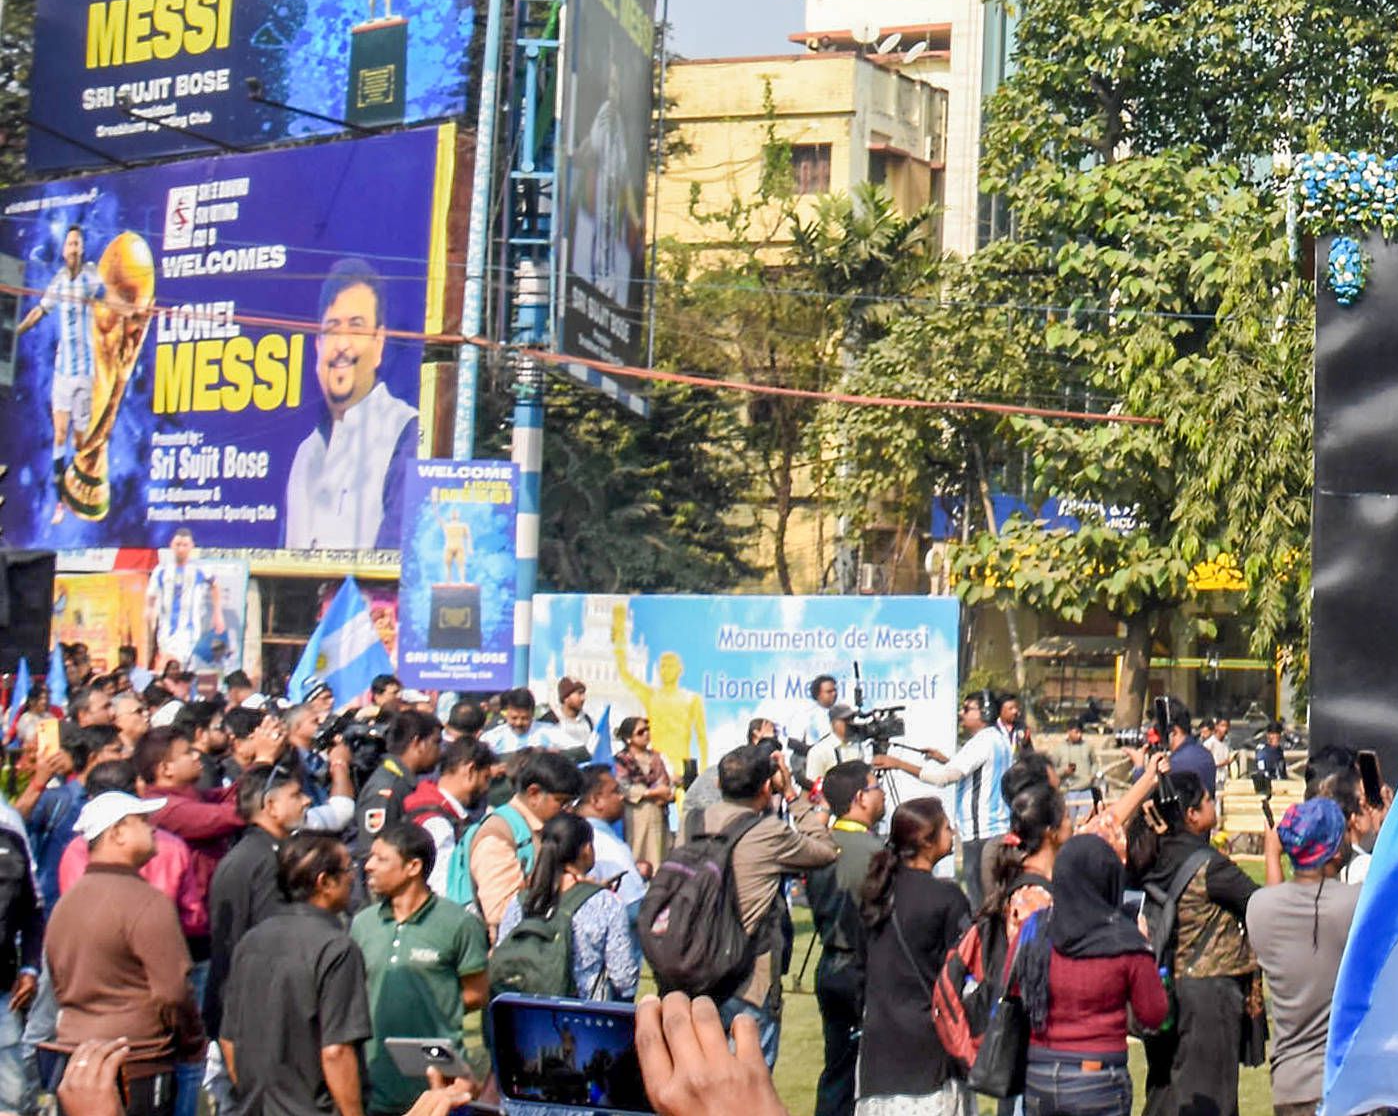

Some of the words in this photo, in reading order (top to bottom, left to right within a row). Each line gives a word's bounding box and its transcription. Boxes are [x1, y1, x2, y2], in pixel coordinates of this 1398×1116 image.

[82, 86, 114, 110] SRI
[175, 68, 230, 97] BOSE
[162, 245, 287, 278] WELCOMES
[157, 300, 240, 343] LIONEL
[153, 333, 304, 415] MESSI
[150, 447, 176, 480] Sri
[178, 445, 220, 486] Sujit
[223, 445, 270, 479] Bose
[417, 465, 512, 479] WELCOME
[717, 626, 838, 650] Monumento
[845, 626, 869, 650] de
[875, 626, 930, 650] Messi
[472, 652, 508, 663] BOSE
[704, 674, 776, 699] Lionel
[785, 674, 847, 699] Mei
